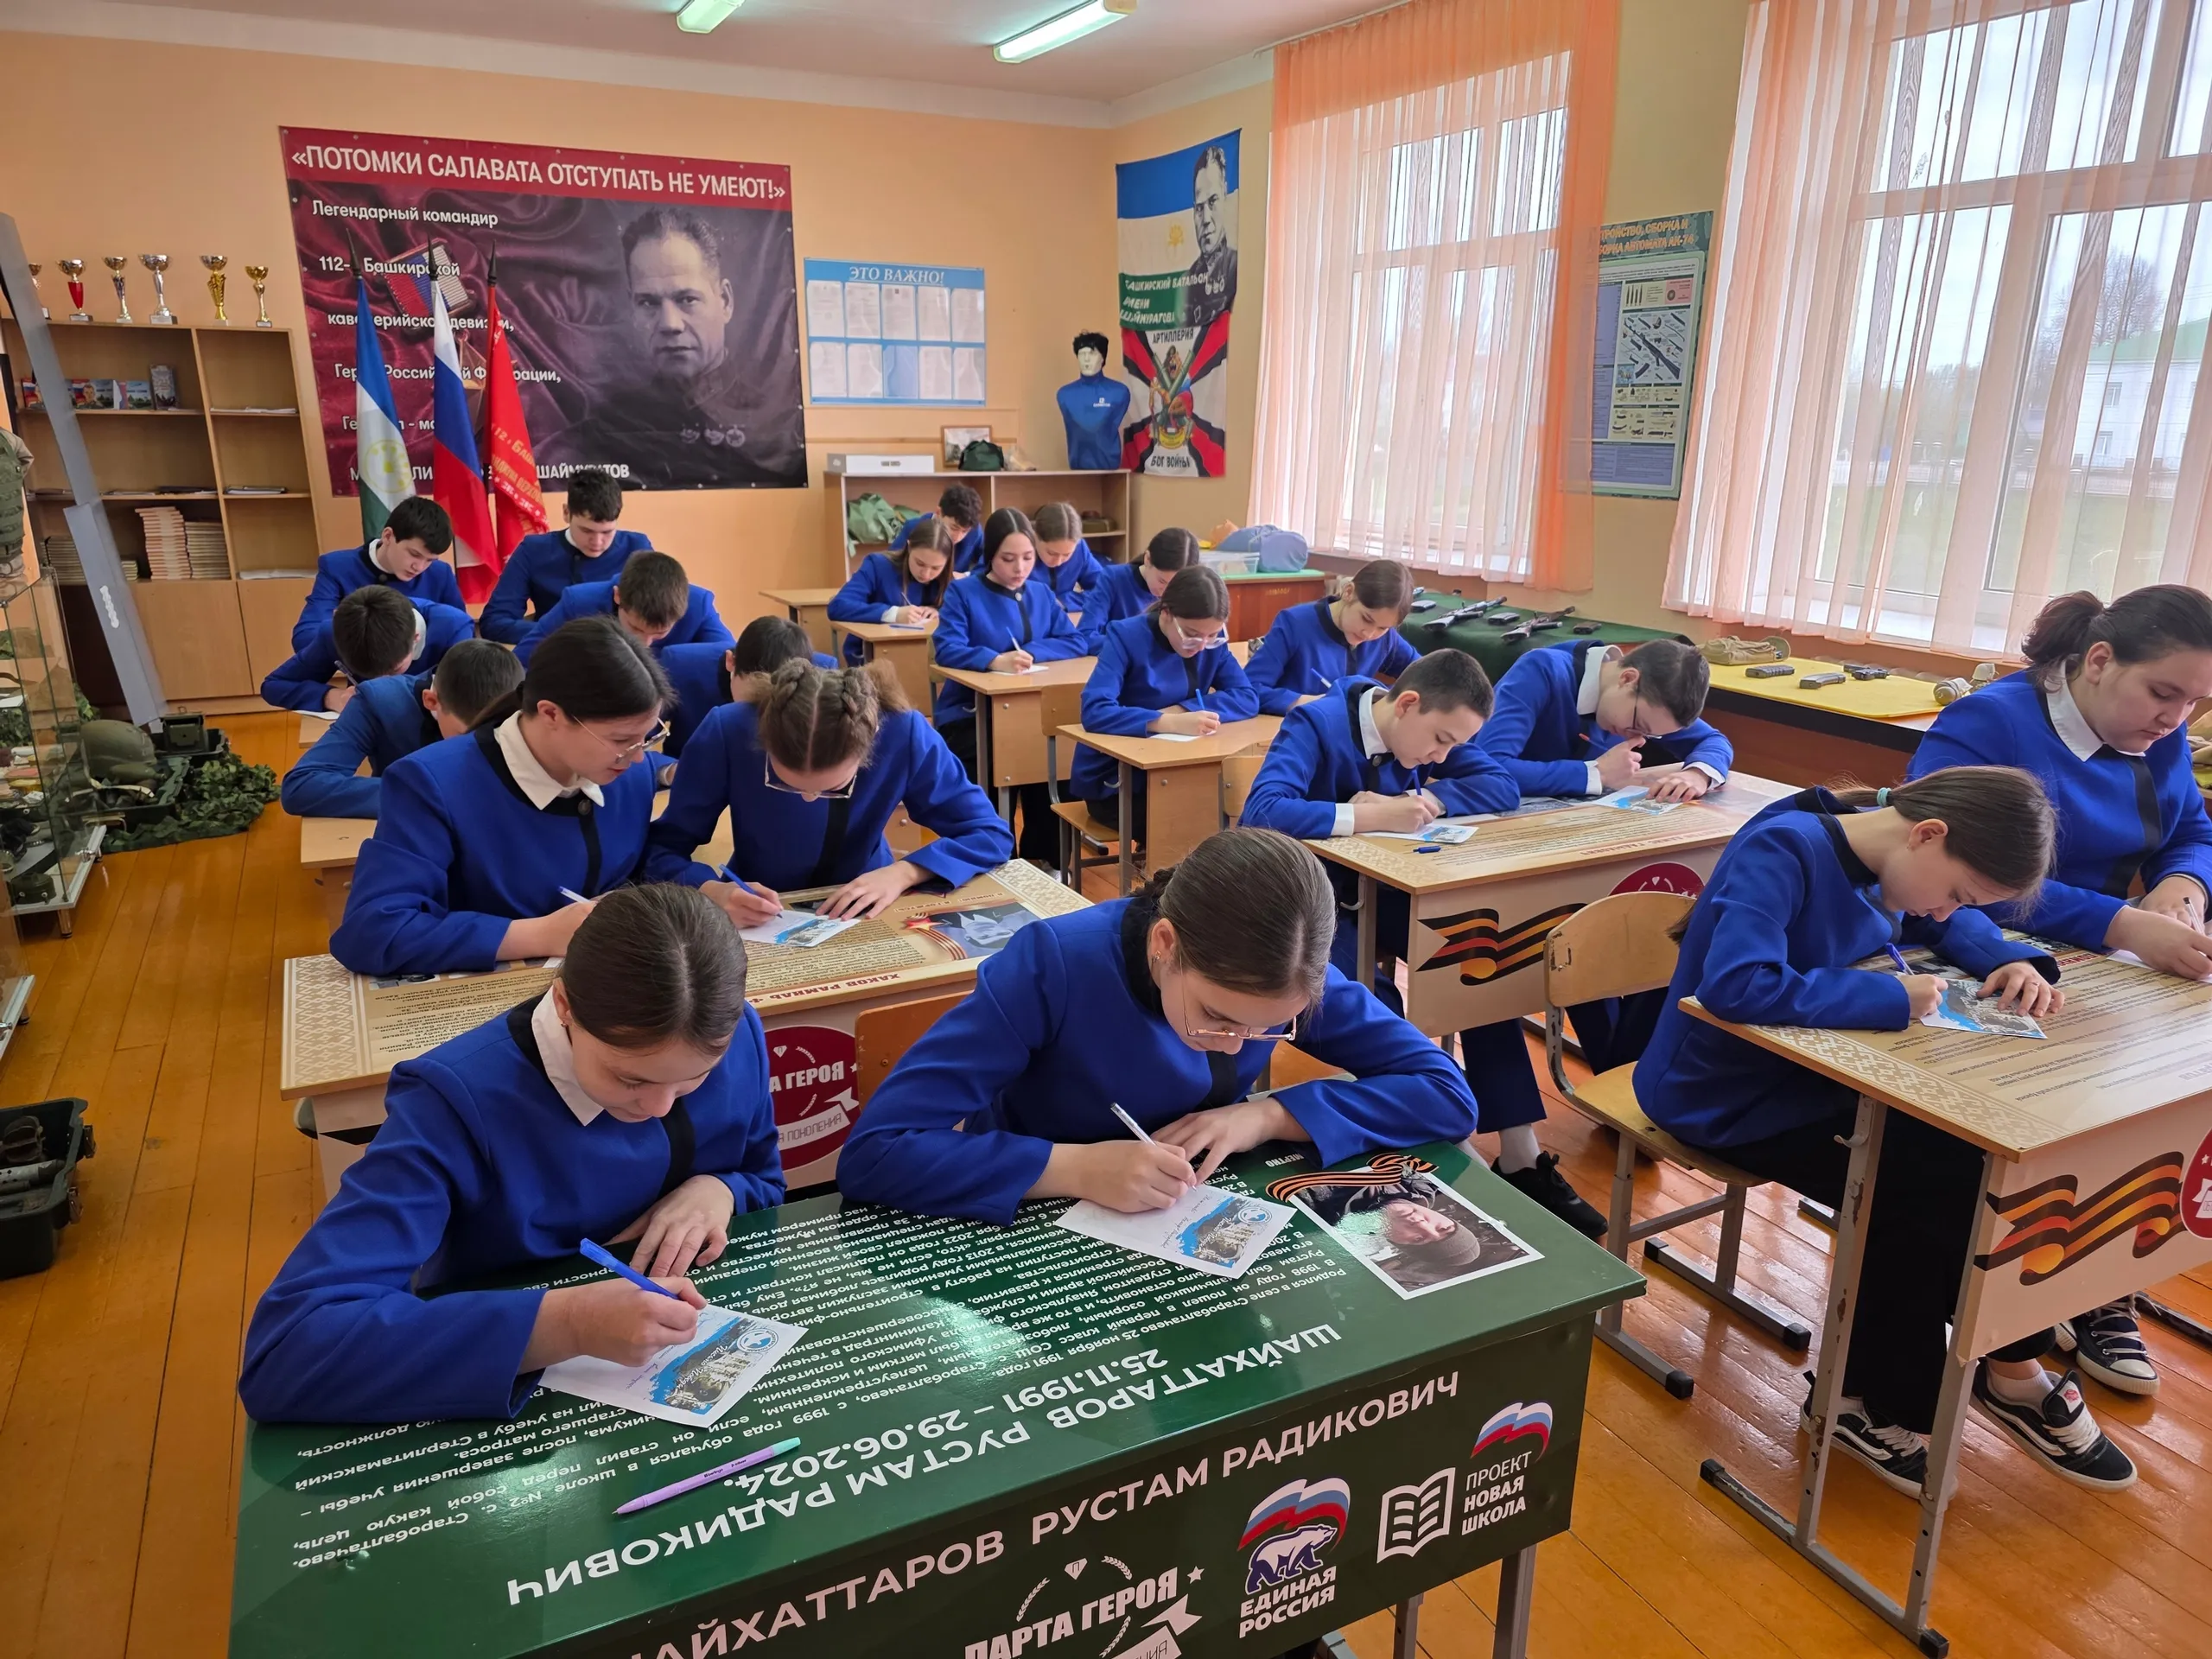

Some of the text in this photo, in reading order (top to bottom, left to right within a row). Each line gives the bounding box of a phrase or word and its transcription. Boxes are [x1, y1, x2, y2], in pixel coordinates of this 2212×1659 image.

[292, 145, 785, 199] «ПОТОМКИ САЛАВАТА ОТСТУПАТЬ НЕ УМЕЮТ!»
[313, 200, 499, 228] Легендарный командир
[1645, 220, 1681, 234] СБОРКА
[1624, 238, 1667, 253] АВТОМАТА
[319, 256, 351, 271] 112-
[849, 266, 944, 283] ЭТО ВАЖНО!
[1172, 273, 1208, 289] БАТАЛЬОН
[1152, 328, 1194, 345] АРТИЛЛЕРИЯ
[1151, 453, 1190, 468] БОГ ВОЙНЫ
[770, 973, 900, 1000] ХАКОВ РАМИЛЬ
[785, 1061, 844, 1090] ГЕРОЯ
[768, 1206, 868, 1234] нас примером
[817, 1212, 879, 1232] орденом
[719, 1220, 890, 1268] проявленные мужество
[787, 1228, 946, 1272] пожалел своей жизни.
[830, 1222, 924, 1251] специальной
[743, 1230, 976, 1294] 2023 года подписал контракт
[754, 1223, 1040, 1303] повторял: «Кто, если мы, Ему
[768, 1246, 831, 1267] военной
[928, 1254, 963, 1268] году
[963, 1247, 995, 1260] 2013
[1010, 1247, 1113, 1280] строительства.
[1276, 1248, 1326, 1268] Рустам
[859, 1262, 929, 1287] родилась
[1085, 1258, 1166, 1286] Российской
[1243, 1263, 1274, 1277] был
[1252, 1271, 1287, 1286] году
[1288, 1262, 1321, 1276] 1998
[1288, 1266, 1347, 1289] Родился
[791, 1282, 860, 1306] любимая
[815, 1264, 964, 1310] умениями заслужил
[1037, 1279, 1085, 1298] армии
[1180, 1289, 1228, 1307] пошел
[1247, 1287, 1281, 1300] селе
[750, 1299, 789, 1315] дочь
[1077, 1299, 1147, 1325] озорным,
[1103, 1307, 1162, 1332] первый
[1136, 1294, 1250, 1335] Старобалтачево
[751, 1240, 1314, 1406] его остановить, был мягким искренним.
[842, 1318, 946, 1354] Калининград
[1057, 1326, 1101, 1344] класс
[296, 1245, 1078, 1460] поступил работу должность,
[1013, 1341, 1053, 1359] СОШ
[1065, 1332, 1122, 1357] ноября
[988, 1359, 1031, 1378] года.
[1030, 1351, 1064, 1367] 1991
[295, 1255, 1126, 1491] стремился развитию, учебу Стерлитамакский
[853, 1358, 988, 1406] Старобалтачево,
[1002, 1348, 1169, 1414] 25.11.1991
[319, 1266, 1173, 1515] студентом Янаульского филиала Уфимского после завершения учебы
[760, 1362, 928, 1417] целеустремленным,
[540, 1404, 626, 1436] старшего
[706, 1414, 750, 1433] если
[741, 1418, 783, 1438] года
[790, 1406, 830, 1425] 1999
[453, 1429, 536, 1460] матроса.
[594, 1440, 659, 1465] ставил
[648, 1432, 734, 1467] обучался
[723, 1410, 969, 1497] 29.06.2024.
[506, 1324, 1343, 1605] ШАЙХАТТАРОВ РУСТАМ РАДИКОВИЧ
[521, 1460, 582, 1486] перед
[1465, 1451, 1533, 1491] ПРОЕКТ
[553, 1468, 616, 1493] школе
[1464, 1475, 1525, 1513] НОВАЯ
[447, 1484, 507, 1510] собой
[365, 1503, 431, 1531] какую
[632, 1371, 1459, 1659] АЙХАТТАРОВ РУСТАМ РАДИКОВИЧ
[1461, 1496, 1527, 1535] ШКОЛА
[291, 1509, 469, 1573] Старобалтачево.
[293, 1526, 349, 1553] цель,
[1082, 1567, 1178, 1630] ГЕРОЯ
[1240, 1566, 1337, 1618] ЕДИНАЯ
[1239, 1585, 1335, 1638] РОССИЯ
